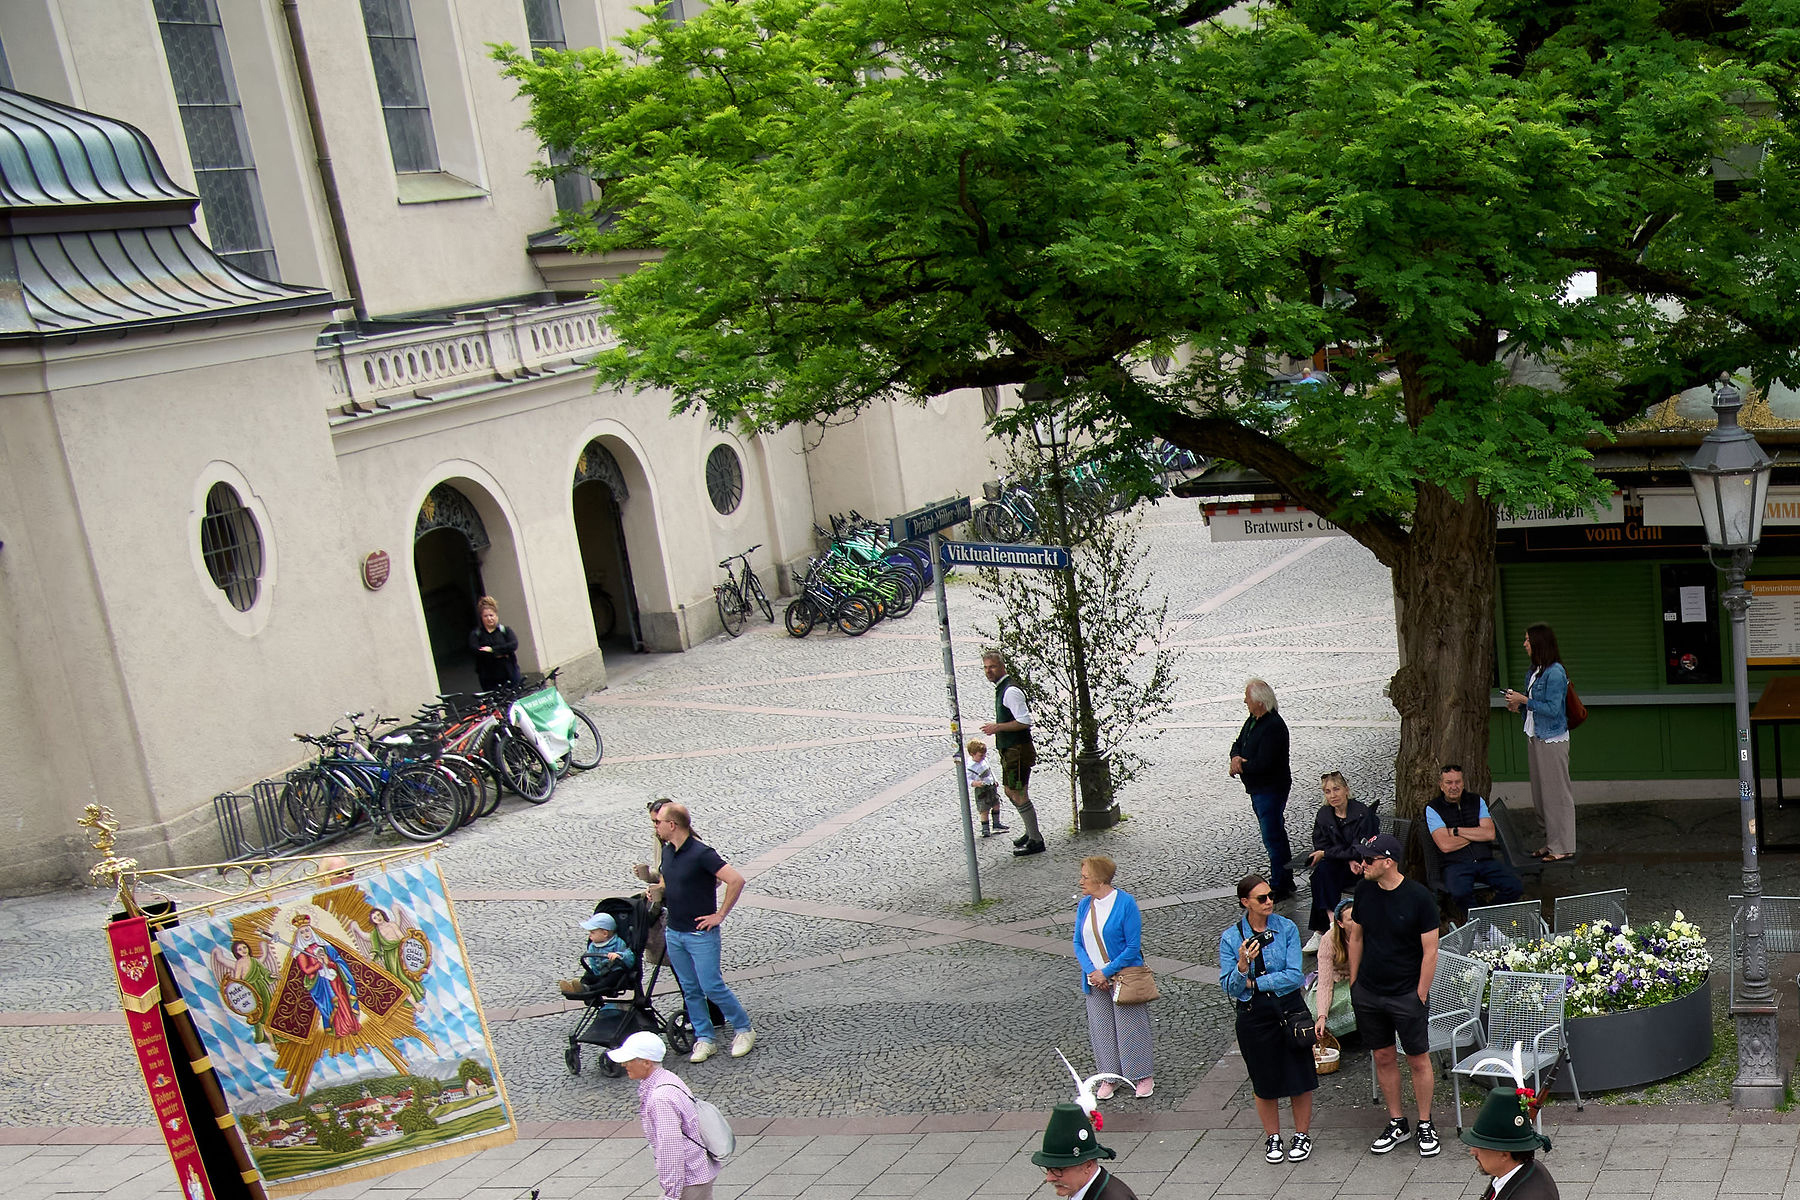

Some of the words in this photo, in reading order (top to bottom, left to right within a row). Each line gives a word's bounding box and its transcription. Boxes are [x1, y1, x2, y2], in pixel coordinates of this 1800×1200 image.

[1244, 517, 1304, 535] Bratwurst
[1585, 527, 1622, 542] vom
[1625, 522, 1663, 541] Grill
[947, 544, 1059, 566] Viktualienmarkt
